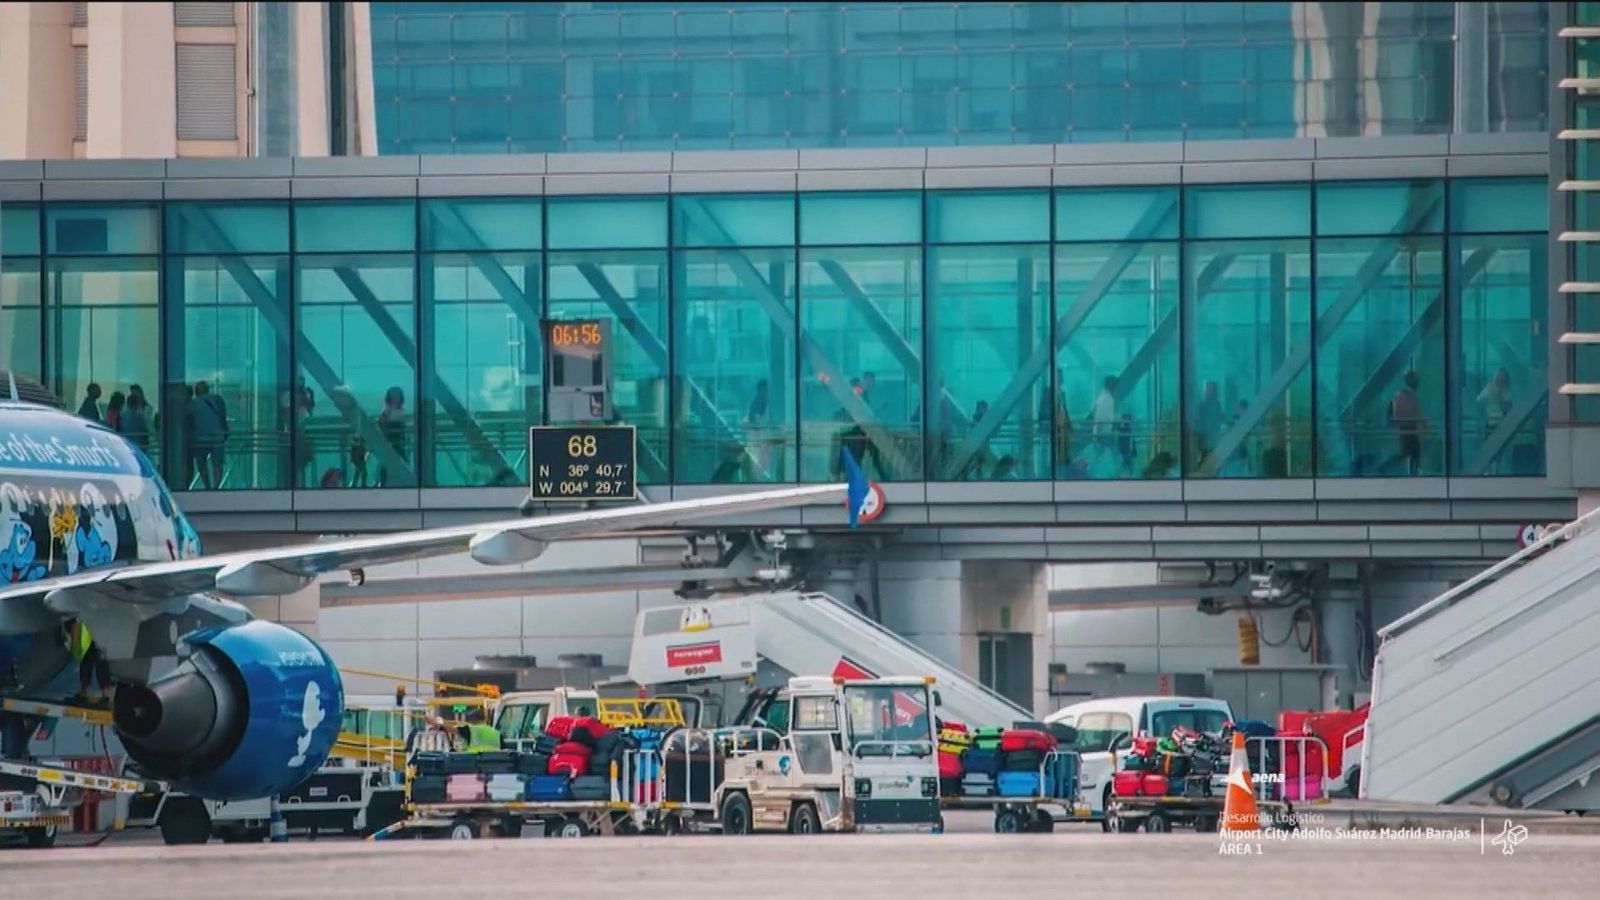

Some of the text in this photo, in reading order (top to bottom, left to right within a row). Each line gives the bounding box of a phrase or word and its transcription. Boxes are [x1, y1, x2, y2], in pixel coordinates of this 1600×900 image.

[552, 324, 602, 345] 06:56
[568, 435, 597, 457] 68
[539, 464, 550, 477] N
[539, 483, 553, 494] W
